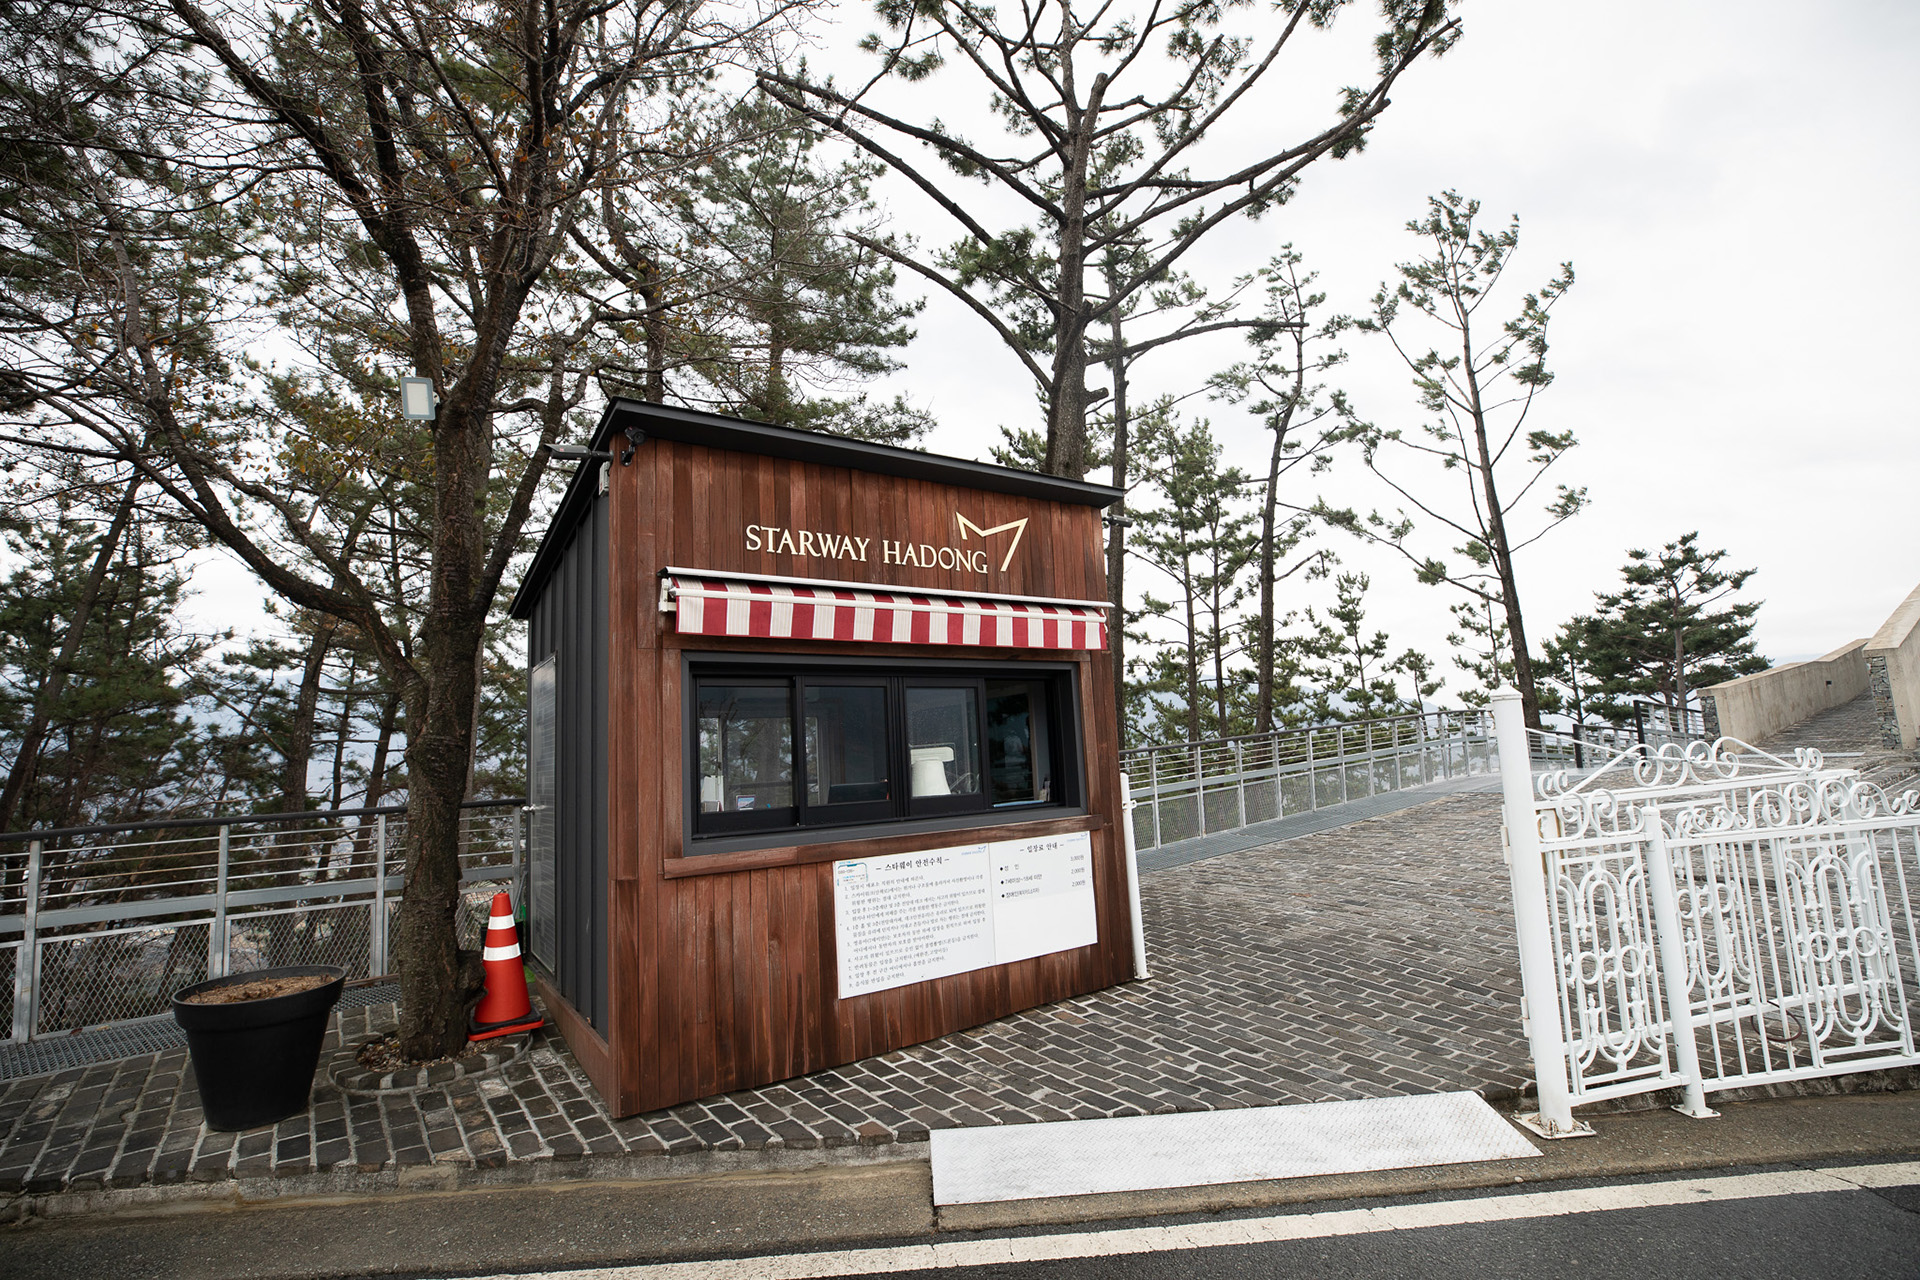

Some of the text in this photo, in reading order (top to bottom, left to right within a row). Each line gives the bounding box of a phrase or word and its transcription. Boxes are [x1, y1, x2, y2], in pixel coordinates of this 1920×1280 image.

[745, 524, 988, 574] STARWAY HADONG
[1027, 844, 1044, 853] 입장료
[1046, 842, 1058, 850] 안내
[884, 860, 912, 871] 스타웨이
[915, 857, 942, 867] 안전수칙
